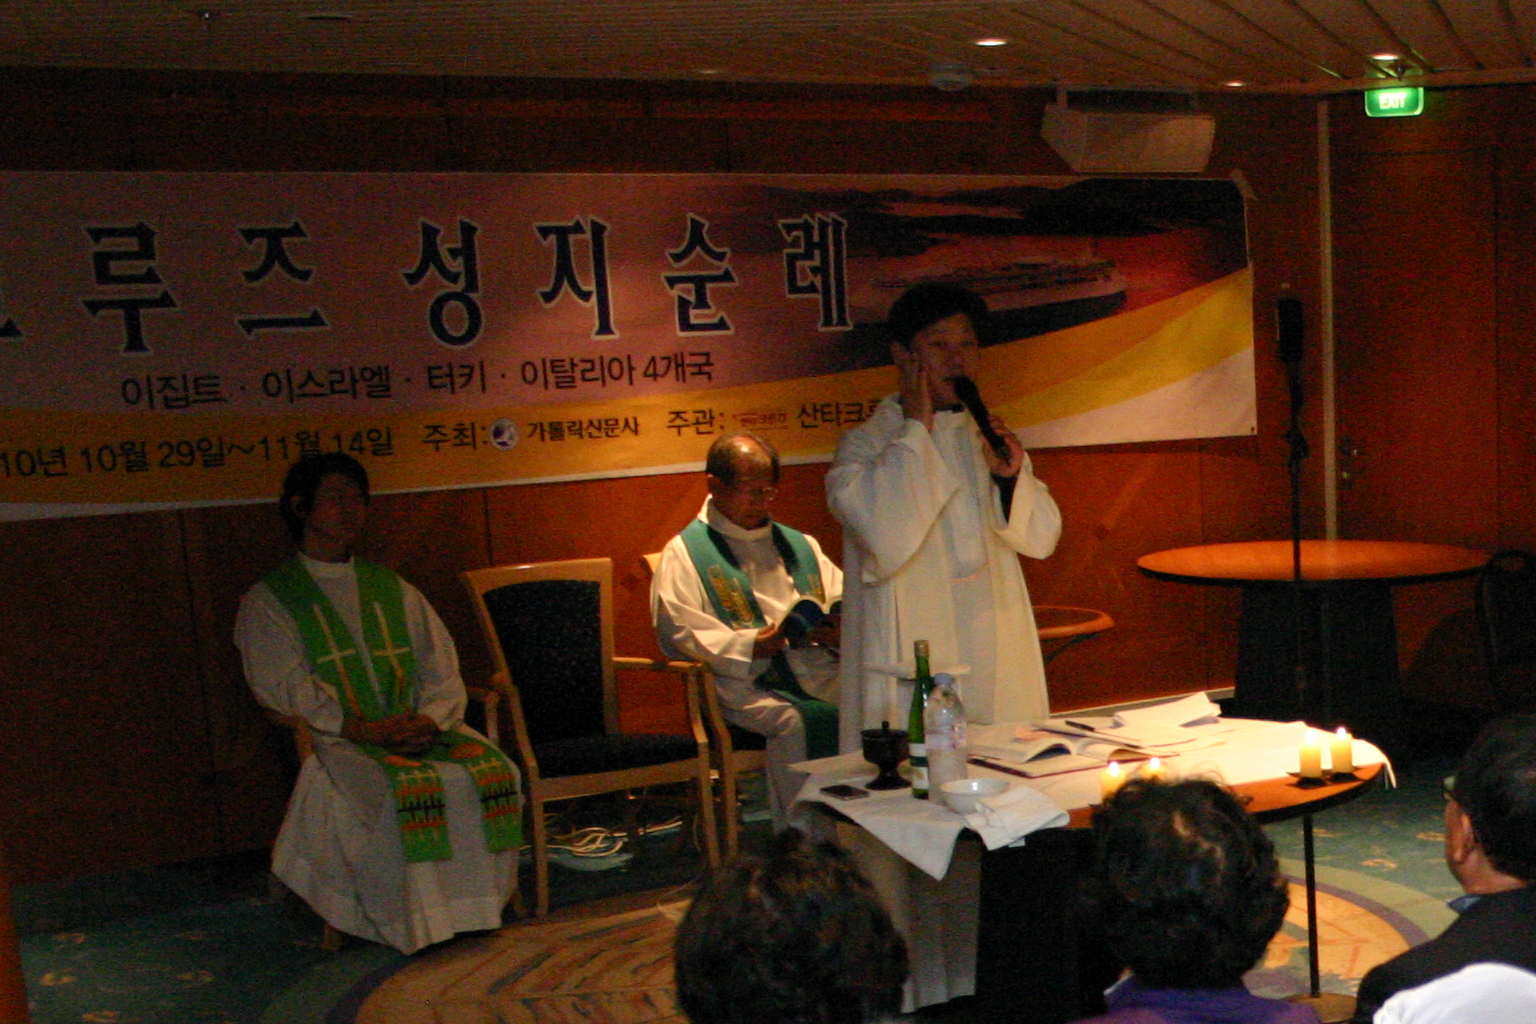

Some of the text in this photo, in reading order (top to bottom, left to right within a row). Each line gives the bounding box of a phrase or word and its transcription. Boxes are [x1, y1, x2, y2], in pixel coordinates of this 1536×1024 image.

[1378, 92, 1408, 110] EXIT
[120, 351, 714, 410] 이집트 이스라엘 터키 이탈리아 4개국
[79, 440, 149, 474] 10월
[667, 408, 726, 437] 주관:
